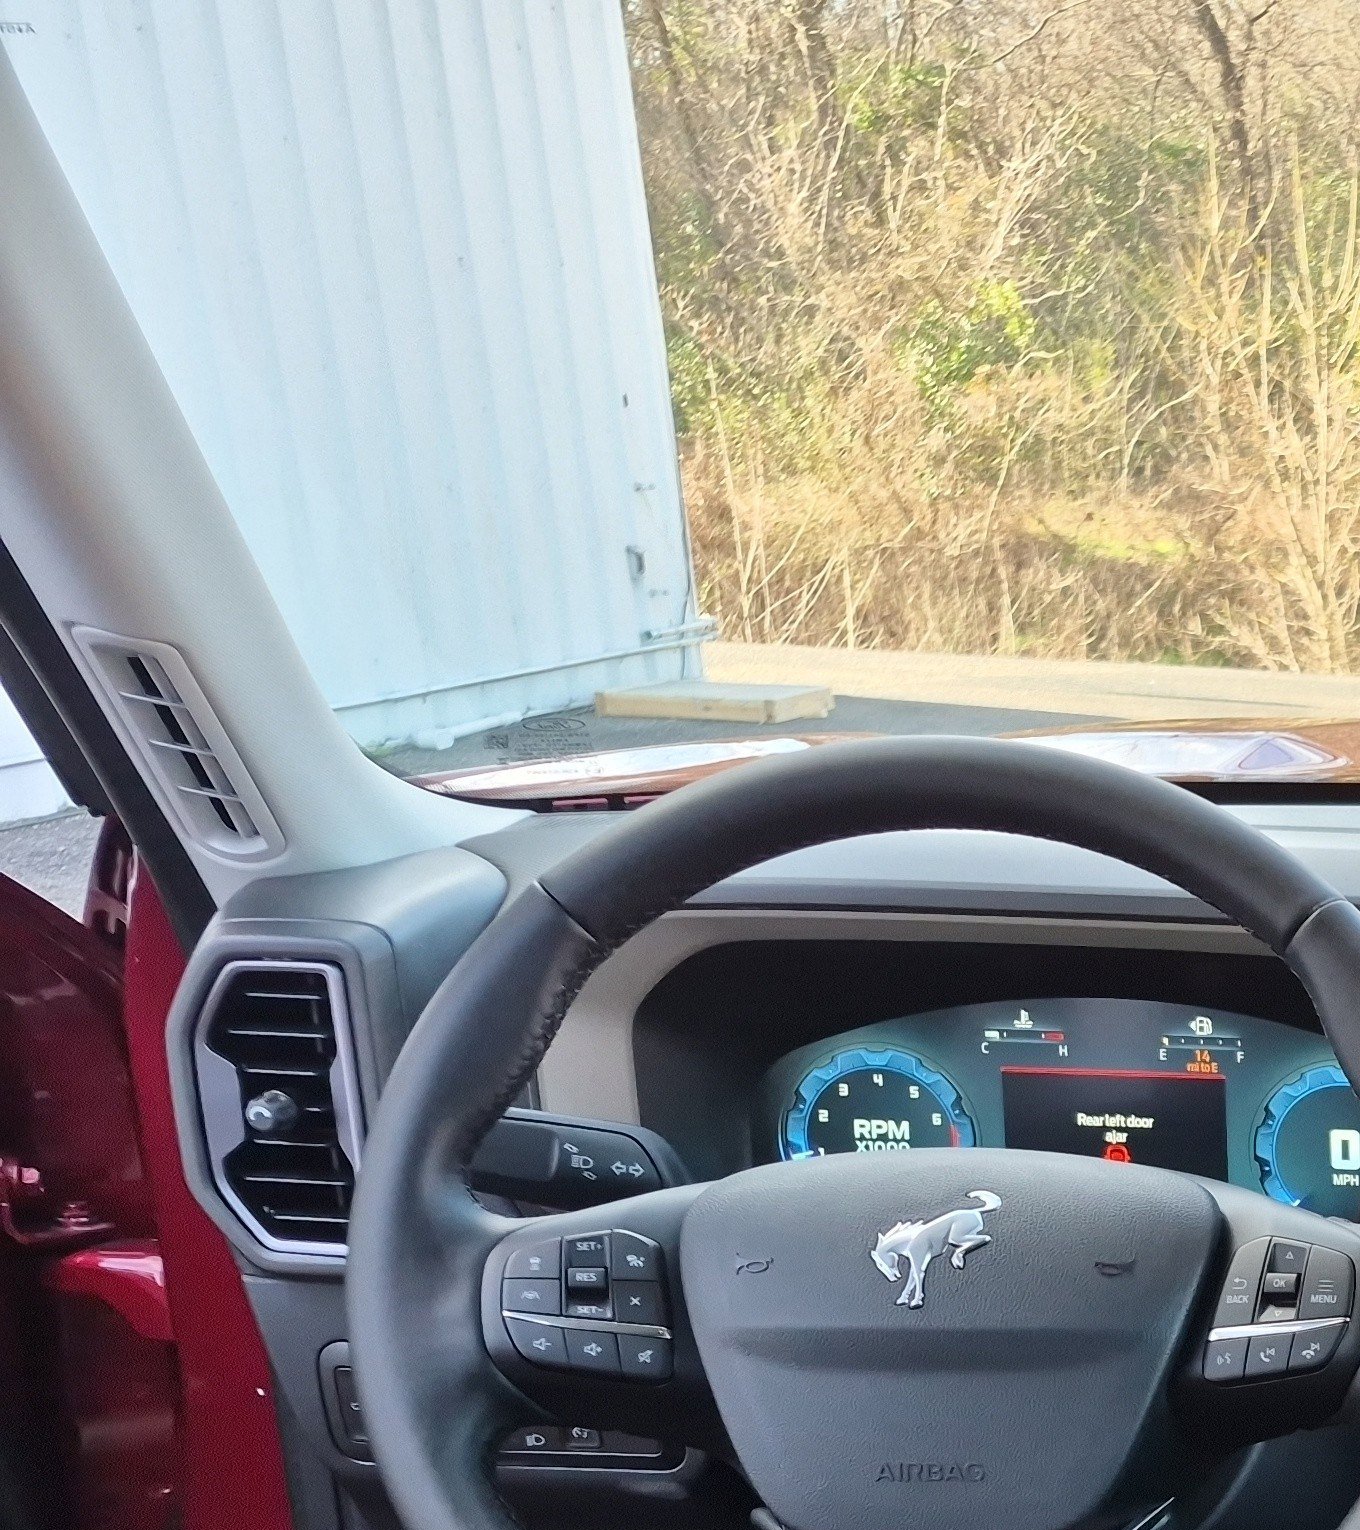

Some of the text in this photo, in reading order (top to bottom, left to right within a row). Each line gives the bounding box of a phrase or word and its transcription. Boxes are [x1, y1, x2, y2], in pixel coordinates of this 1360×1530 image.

[980, 1042, 989, 1054] C
[1058, 1044, 1069, 1057] H
[1158, 1048, 1168, 1061] E
[1195, 1049, 1210, 1062] 14
[1236, 1051, 1245, 1063] F
[1211, 1063, 1219, 1073] E
[872, 1073, 884, 1087] 4
[838, 1083, 849, 1097] 3
[908, 1085, 920, 1099] 5
[818, 1109, 829, 1123] 2
[931, 1113, 942, 1126] 6
[1077, 1112, 1154, 1128] Rear left door
[853, 1118, 911, 1140] RPM
[1105, 1129, 1128, 1144] ajar
[1330, 1128, 1360, 1171] 0
[1332, 1173, 1360, 1187] MPH
[575, 1272, 598, 1282] RES
[1273, 1278, 1286, 1288] OK
[1226, 1294, 1249, 1304] BACK
[1311, 1294, 1337, 1304] MENU
[876, 1462, 986, 1482] AIRBAG
